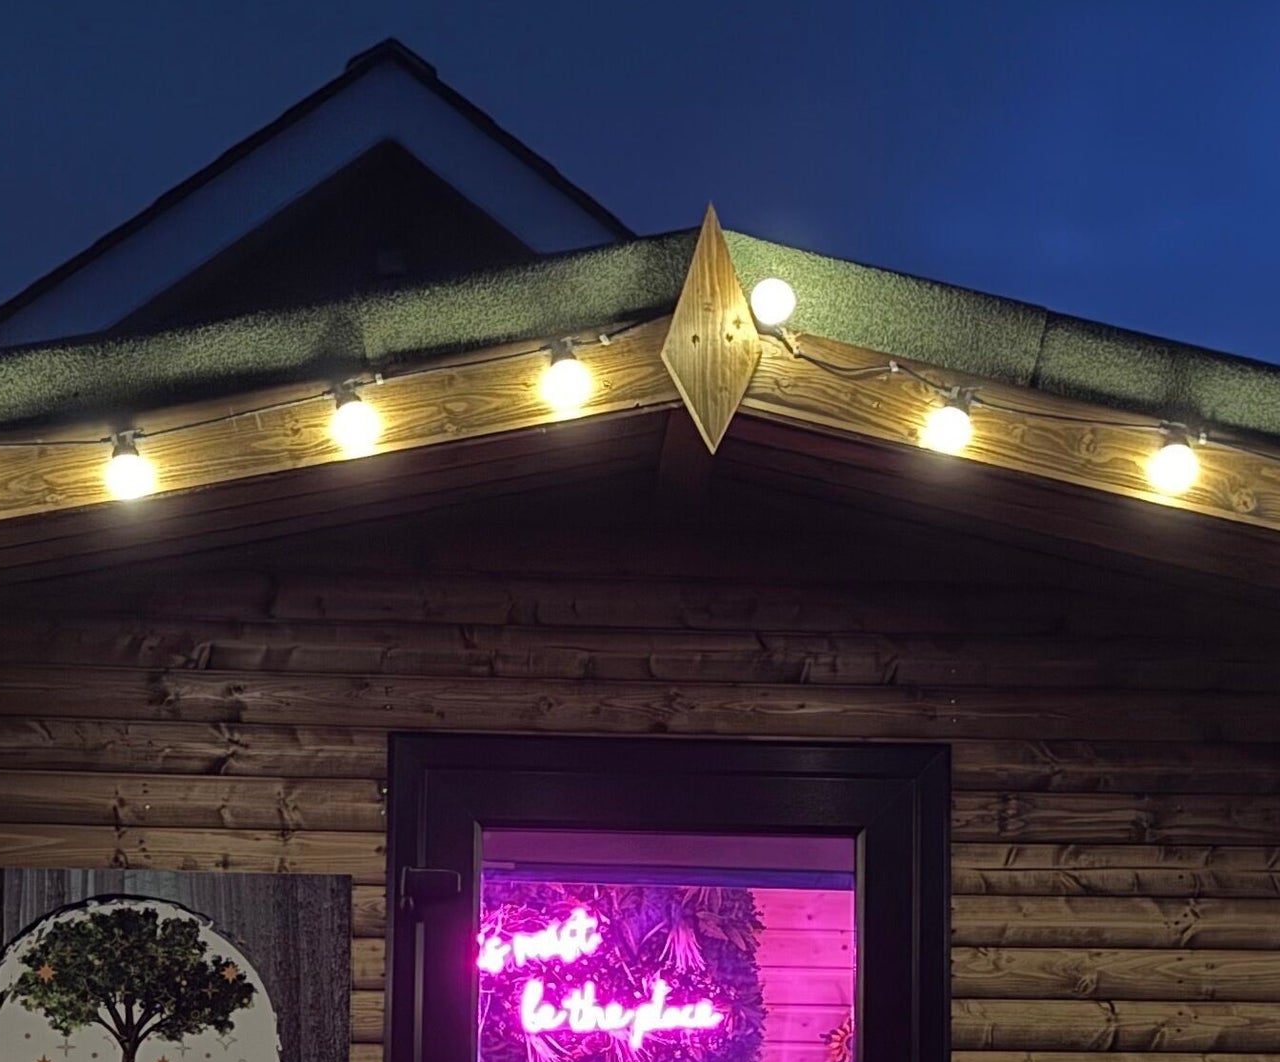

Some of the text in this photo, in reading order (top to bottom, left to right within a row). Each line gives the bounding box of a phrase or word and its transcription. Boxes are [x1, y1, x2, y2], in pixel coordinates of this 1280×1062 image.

[521, 979, 724, 1049] be the place
